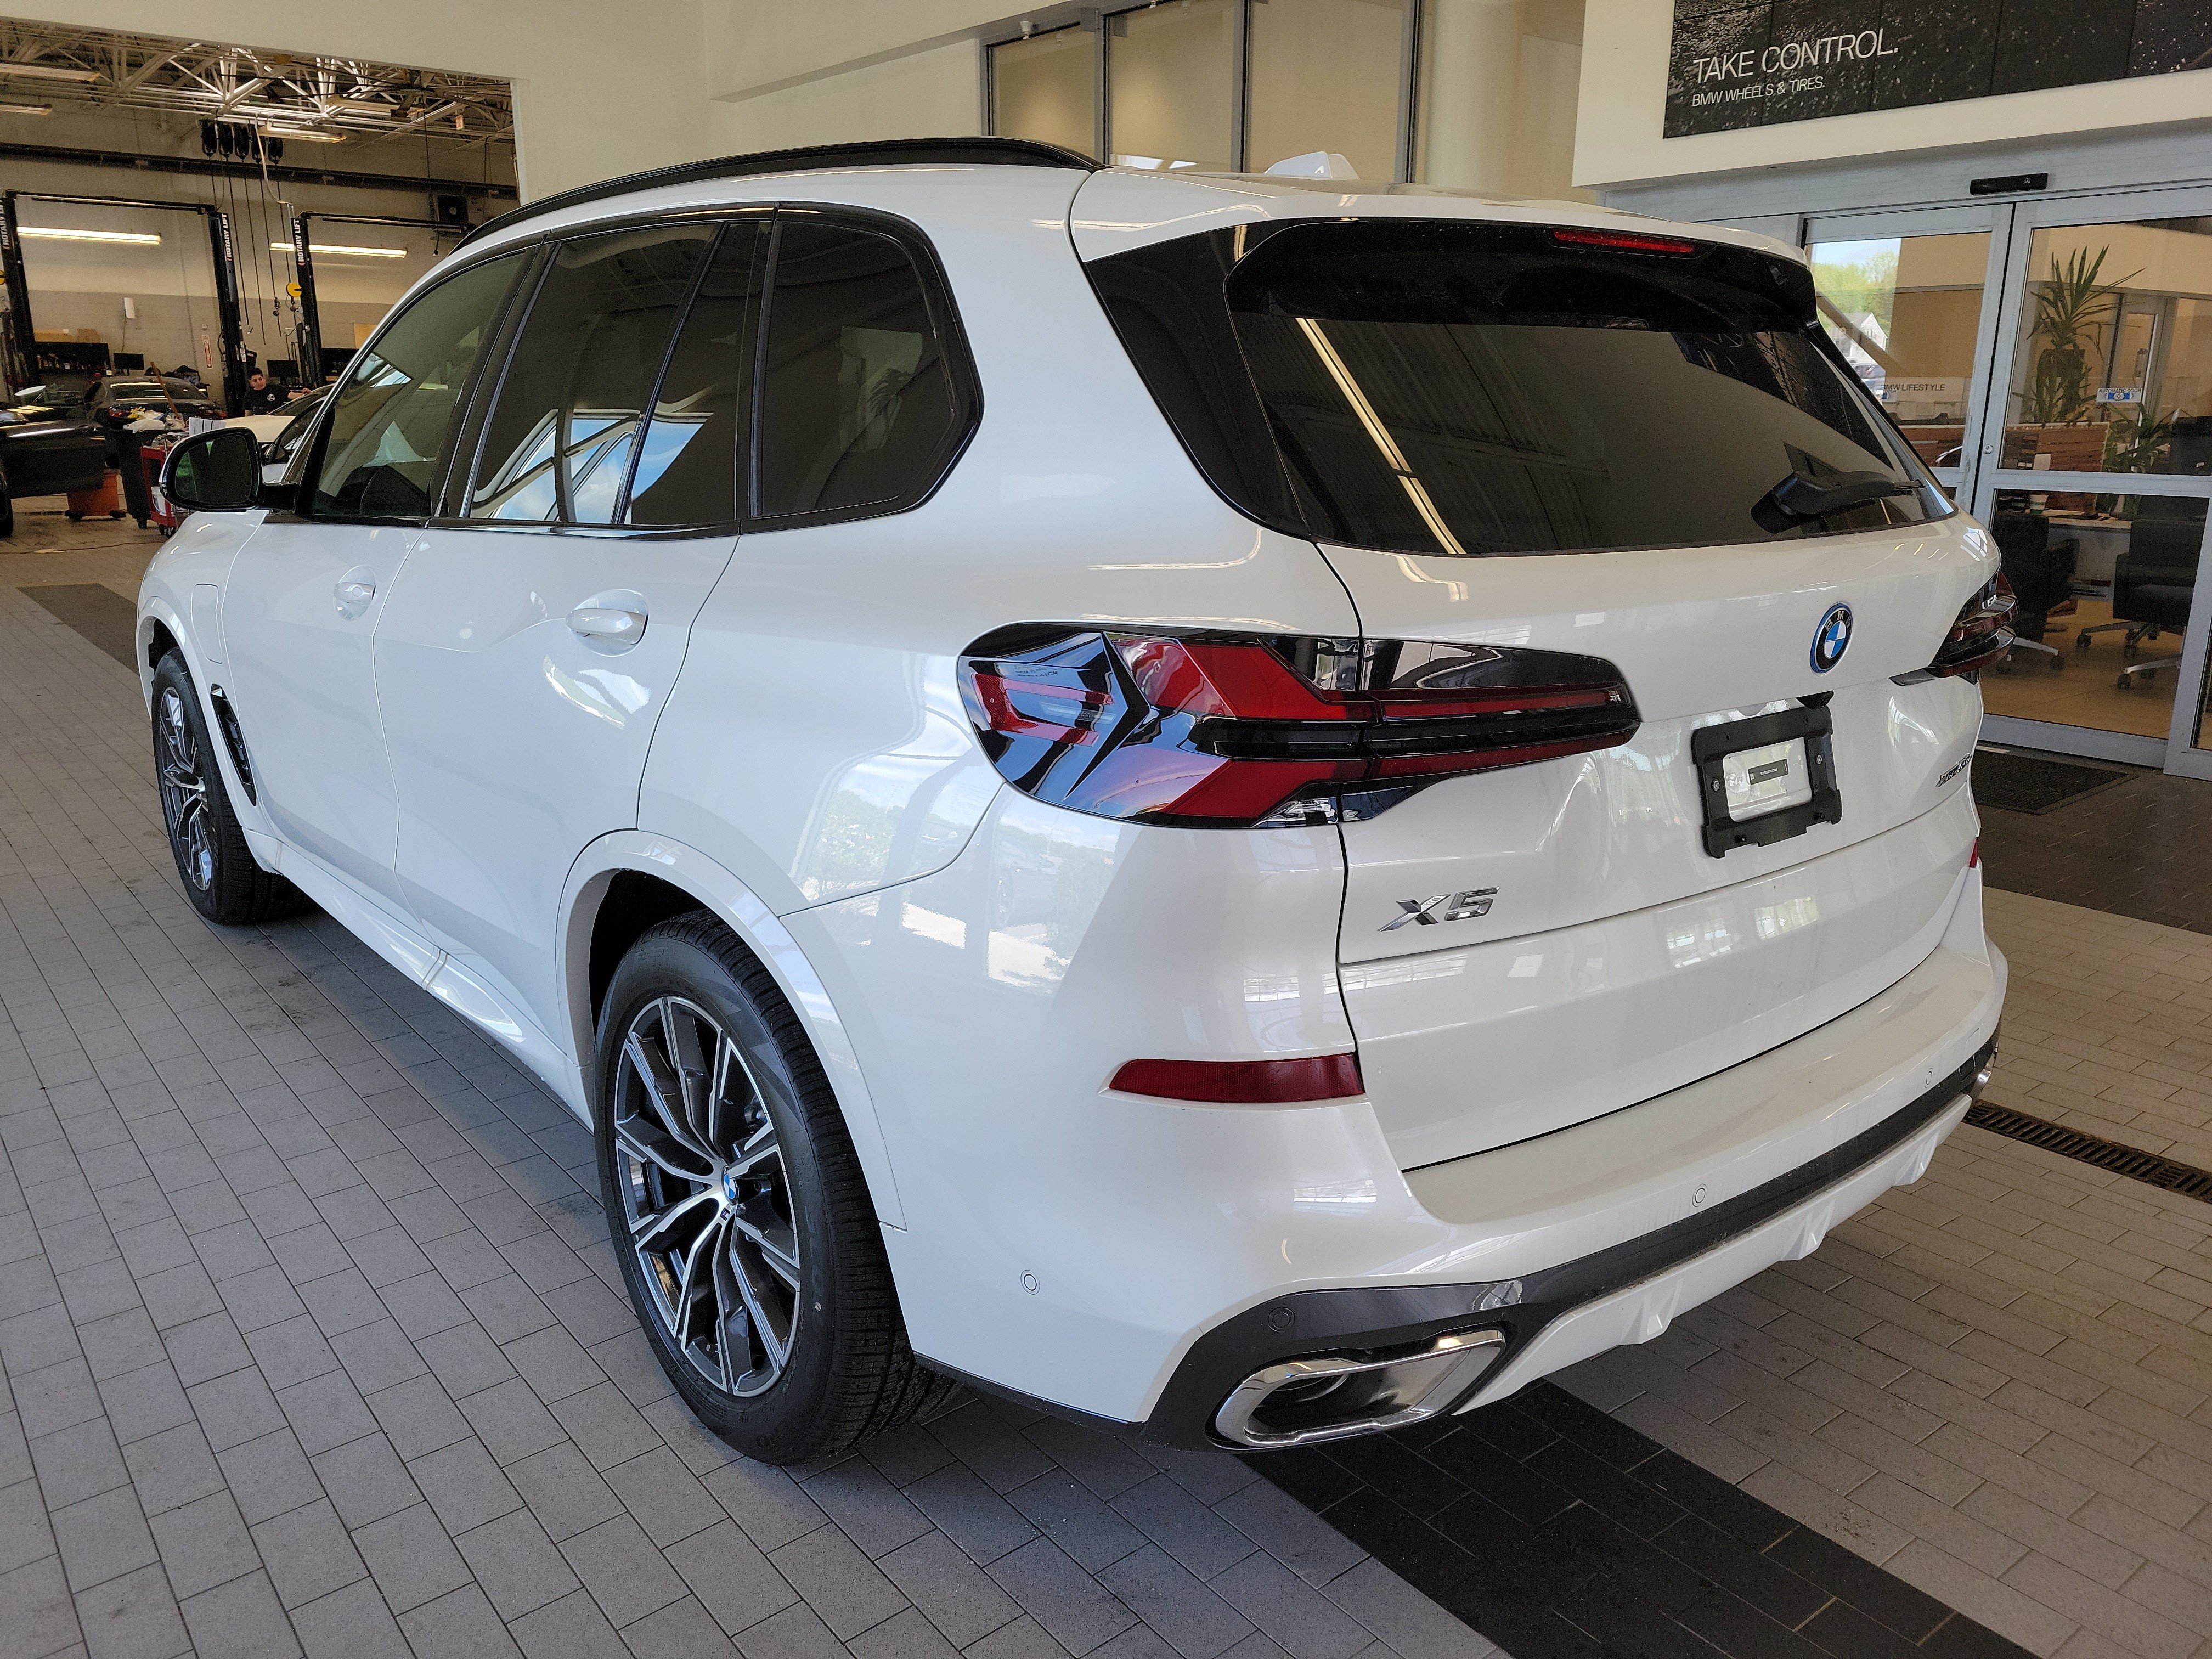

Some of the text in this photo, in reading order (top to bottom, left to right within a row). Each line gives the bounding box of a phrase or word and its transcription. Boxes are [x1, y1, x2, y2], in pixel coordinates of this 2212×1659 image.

[1692, 29, 1899, 83] TAKE CONTROL.
[1692, 76, 1826, 107] BMW WHEELS & TIRES.
[295, 235, 304, 262] ROTARY
[1376, 885, 1500, 932] X5
